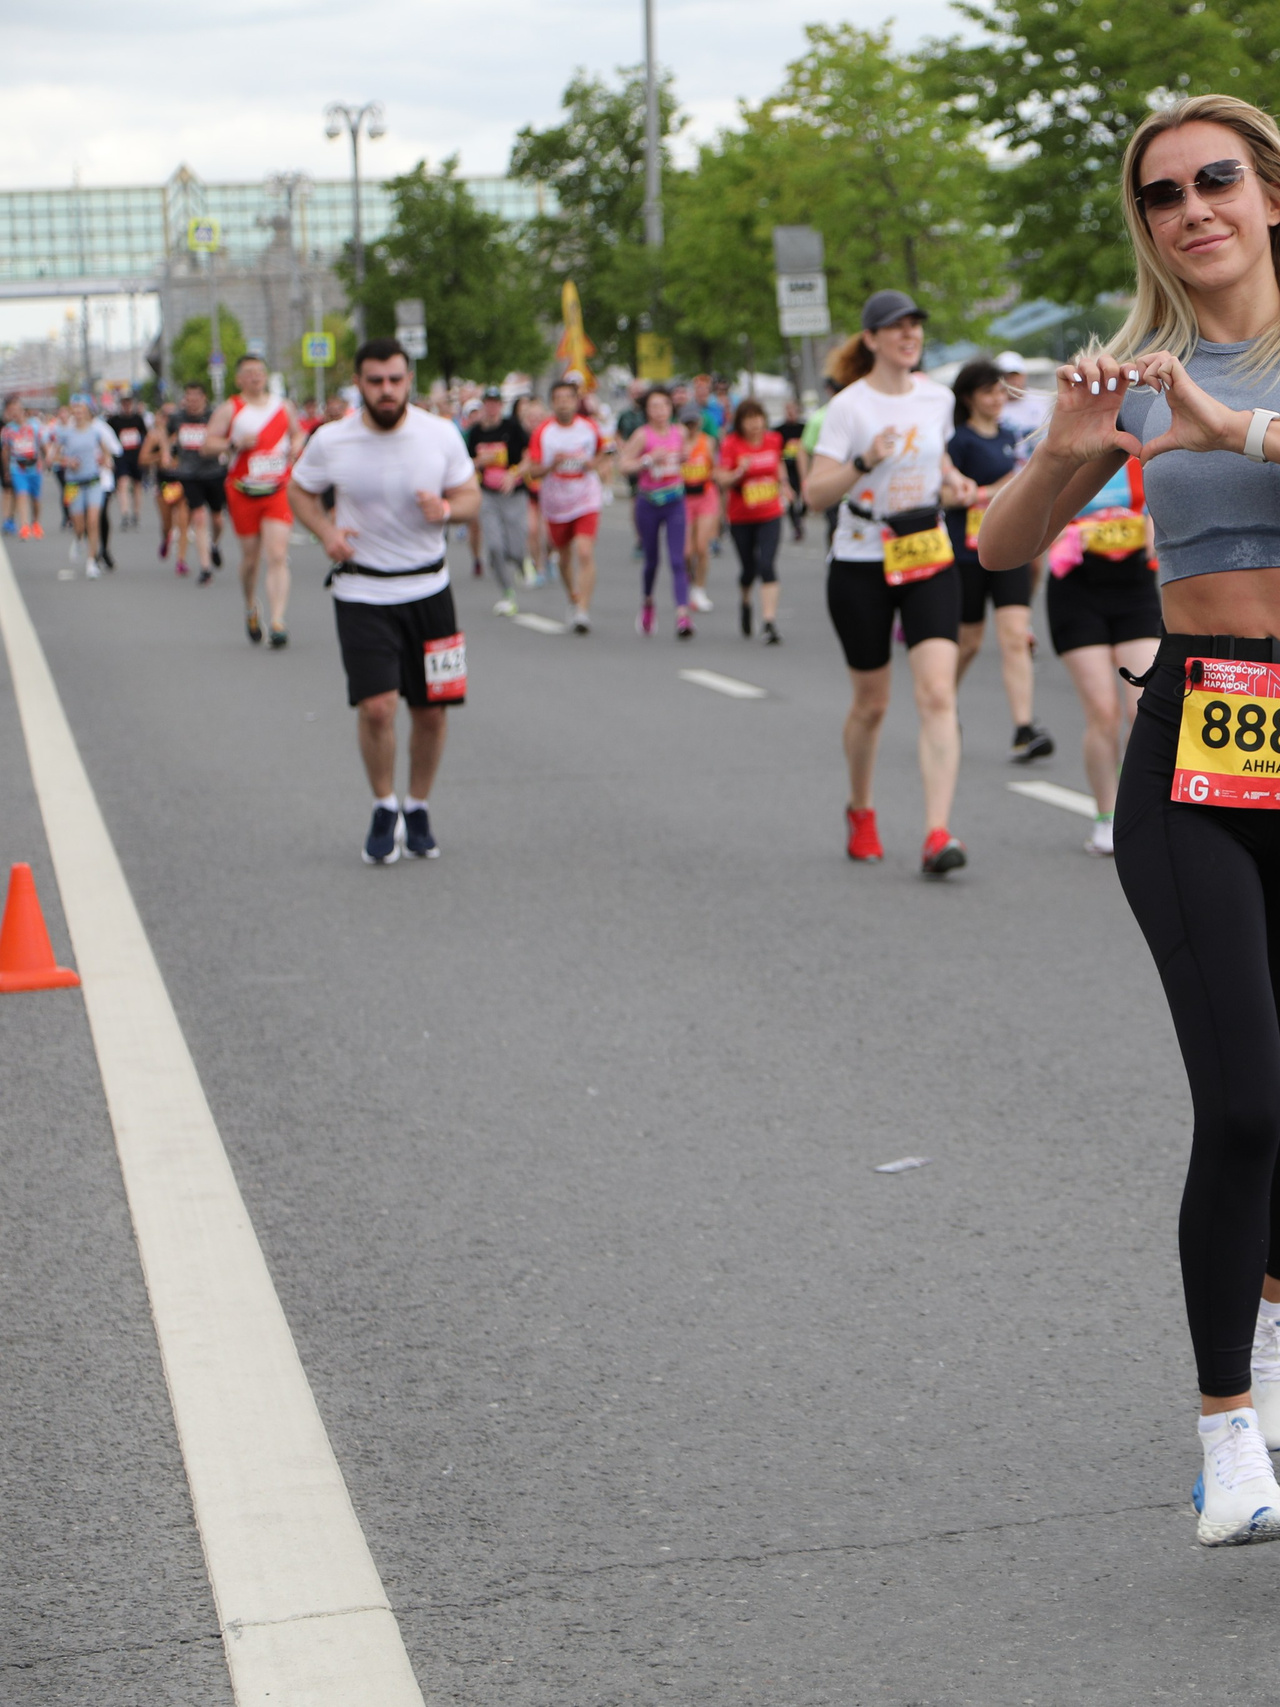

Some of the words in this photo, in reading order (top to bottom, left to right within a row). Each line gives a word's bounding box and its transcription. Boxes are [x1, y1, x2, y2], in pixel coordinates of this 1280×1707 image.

[1203, 662, 1267, 676] МОСКОВСКИЙ
[1203, 680, 1248, 692] МАРАФОН
[1188, 774, 1210, 802] G
